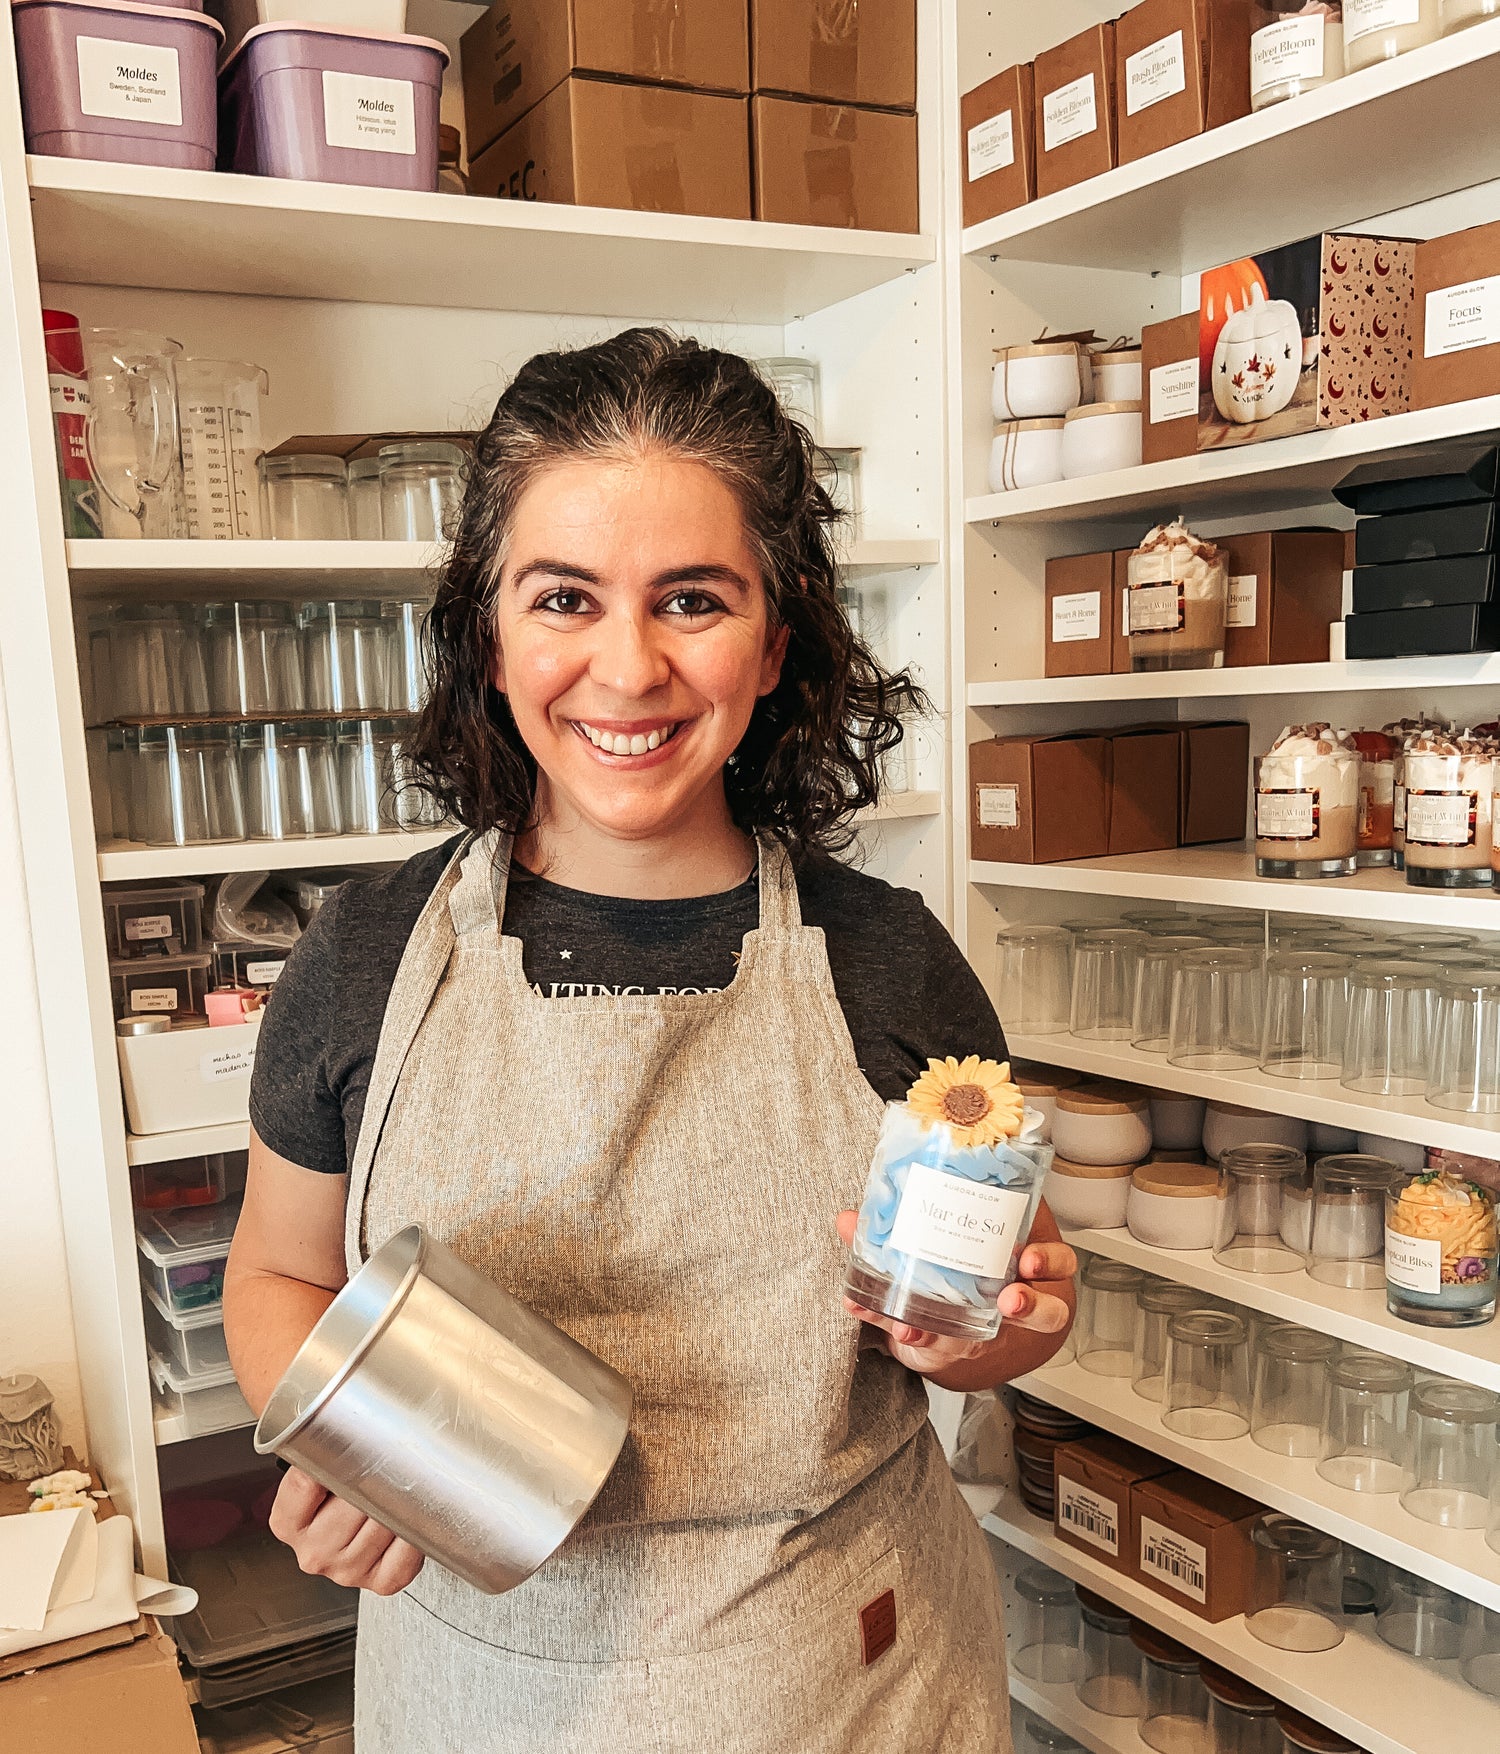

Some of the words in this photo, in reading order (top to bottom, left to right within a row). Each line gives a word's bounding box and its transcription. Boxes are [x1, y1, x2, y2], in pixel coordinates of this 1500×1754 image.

[1280, 38, 1316, 53] Bloom
[1152, 56, 1176, 74] Bloom
[116, 66, 158, 82] Moldes
[138, 86, 166, 96] Scotland
[132, 95, 152, 104] Japan
[358, 98, 395, 112] Moldes
[1449, 305, 1482, 321] Focus
[1161, 380, 1196, 394] Sunshine
[1230, 594, 1253, 604] Home
[528, 982, 645, 998] AITIN
[944, 1182, 976, 1197] AURORA
[978, 1192, 1000, 1202] GLOW
[919, 1200, 953, 1221] Mar
[957, 1213, 978, 1230] de
[981, 1218, 1006, 1236] Sol
[1409, 1255, 1433, 1268] Bliss
